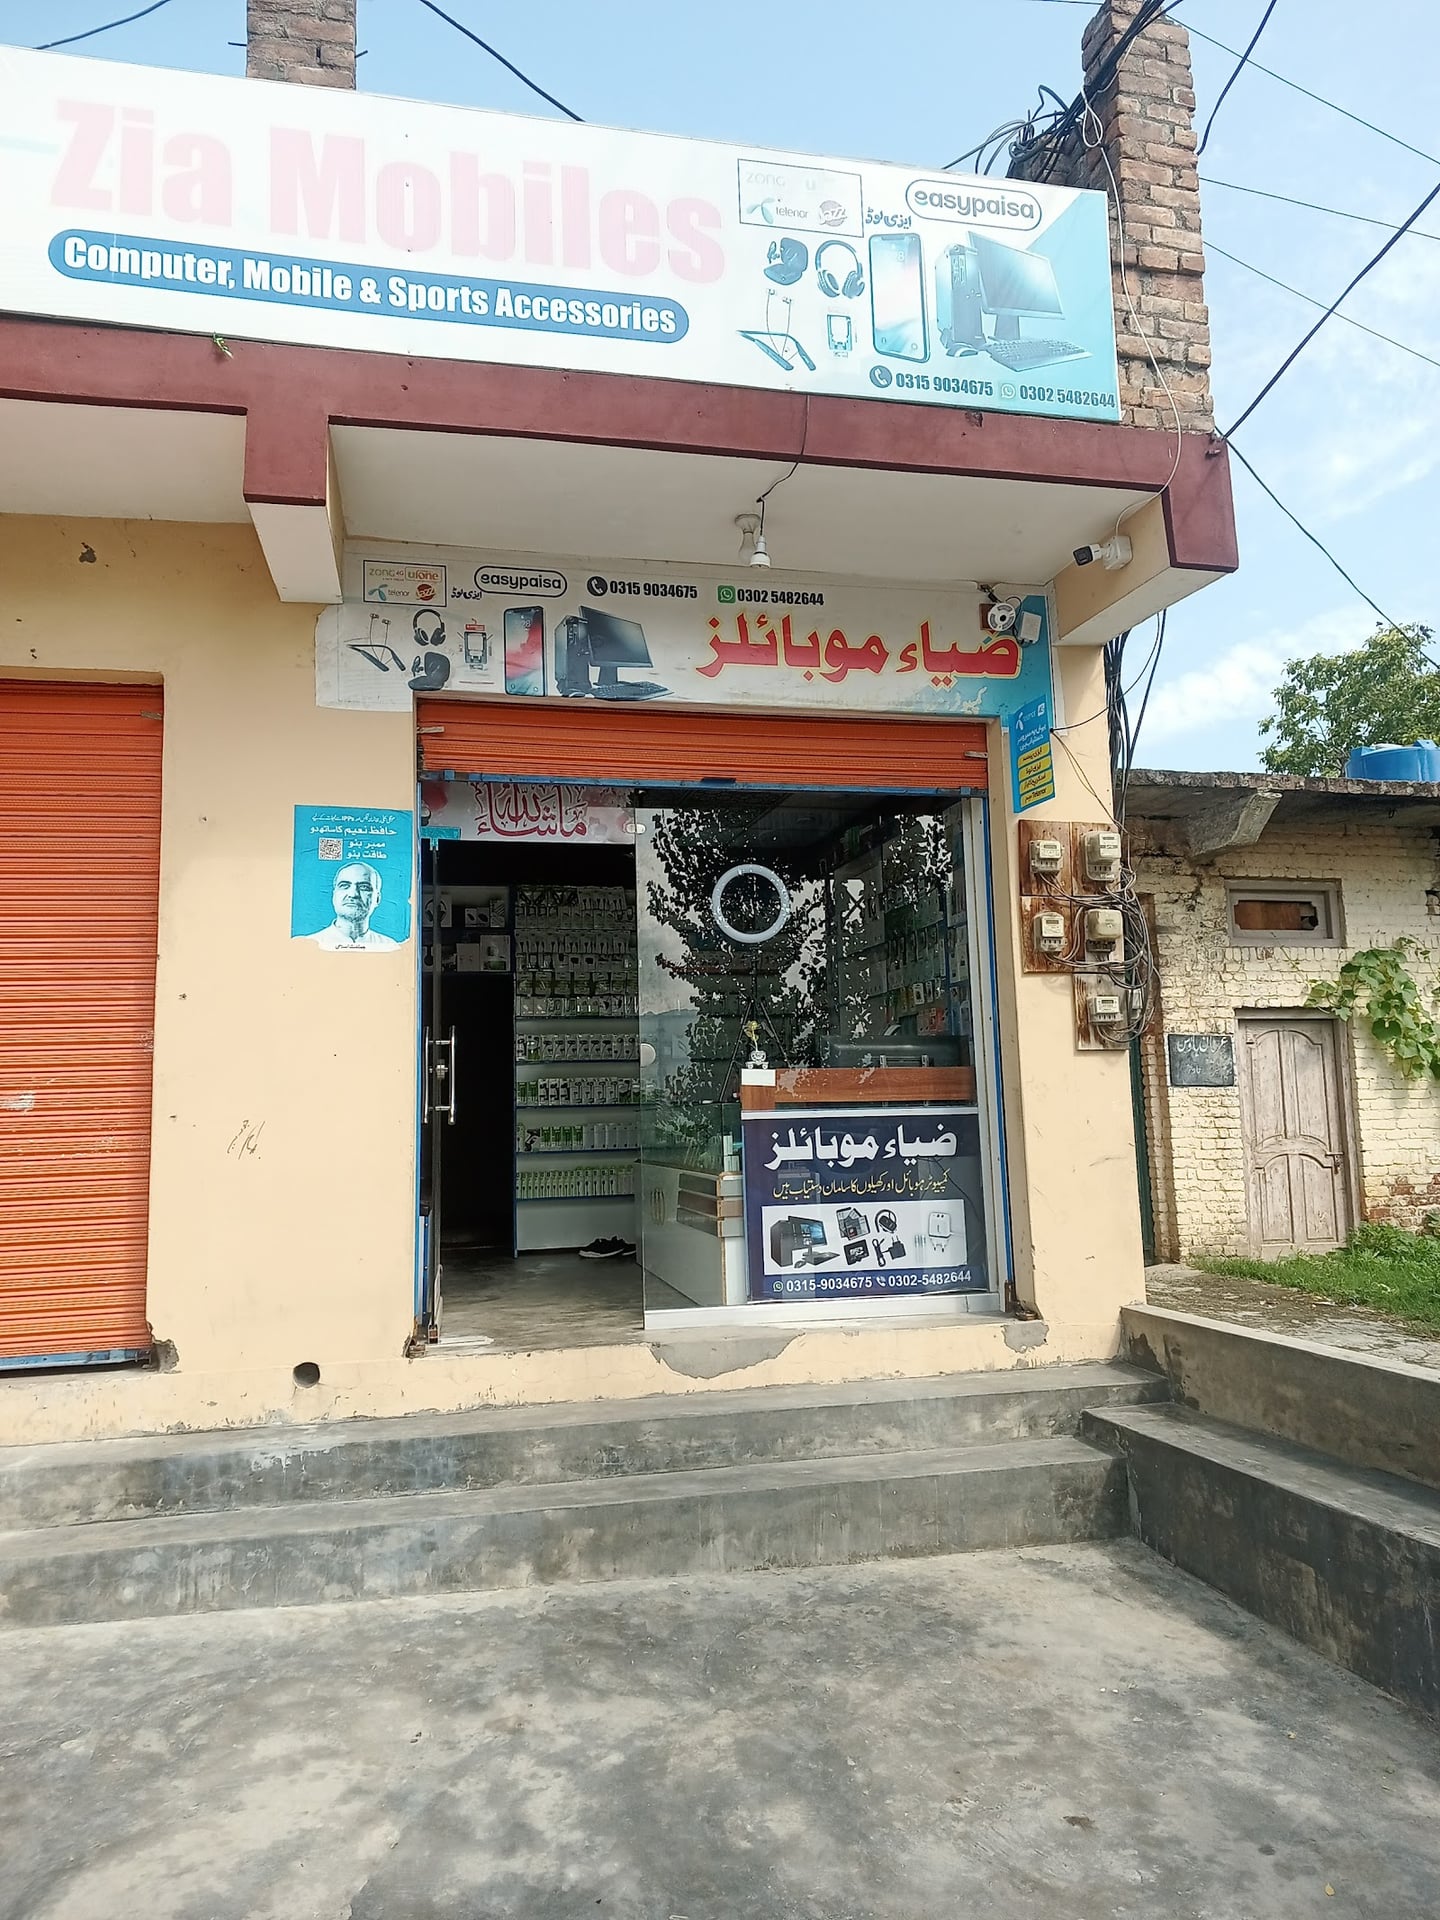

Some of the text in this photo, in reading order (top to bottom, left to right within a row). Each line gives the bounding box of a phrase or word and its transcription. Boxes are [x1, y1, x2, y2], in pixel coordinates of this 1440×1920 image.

[49, 98, 726, 286] Zia Mobiles
[776, 206, 809, 219] telenor
[914, 190, 1035, 219] easypaisa
[64, 236, 677, 334] Computer, Mobile & Sports Accessories
[895, 372, 994, 396] 0315 9034675
[1019, 385, 1116, 408] 0302 5482644
[480, 573, 562, 590] easypaisa
[609, 580, 698, 599] 0315 9034675
[737, 588, 825, 606] 0302 5482644
[695, 611, 1022, 688] ضیاء موبائلز
[343, 825, 368, 837] نعیم
[368, 825, 397, 836] حافظ
[347, 838, 363, 849] بنو
[345, 849, 388, 860] طاقت بنو
[764, 1122, 958, 1170] ضیاء موبائلز
[773, 1181, 791, 1200] ہیں
[789, 1179, 823, 1200] دستیاب
[822, 1178, 851, 1196] سامان
[850, 1178, 858, 1193] کا
[857, 1171, 889, 1195] کھیلوں
[879, 1178, 894, 1192] اور
[786, 1270, 972, 1293] 0315-9034675 0302-5482644
